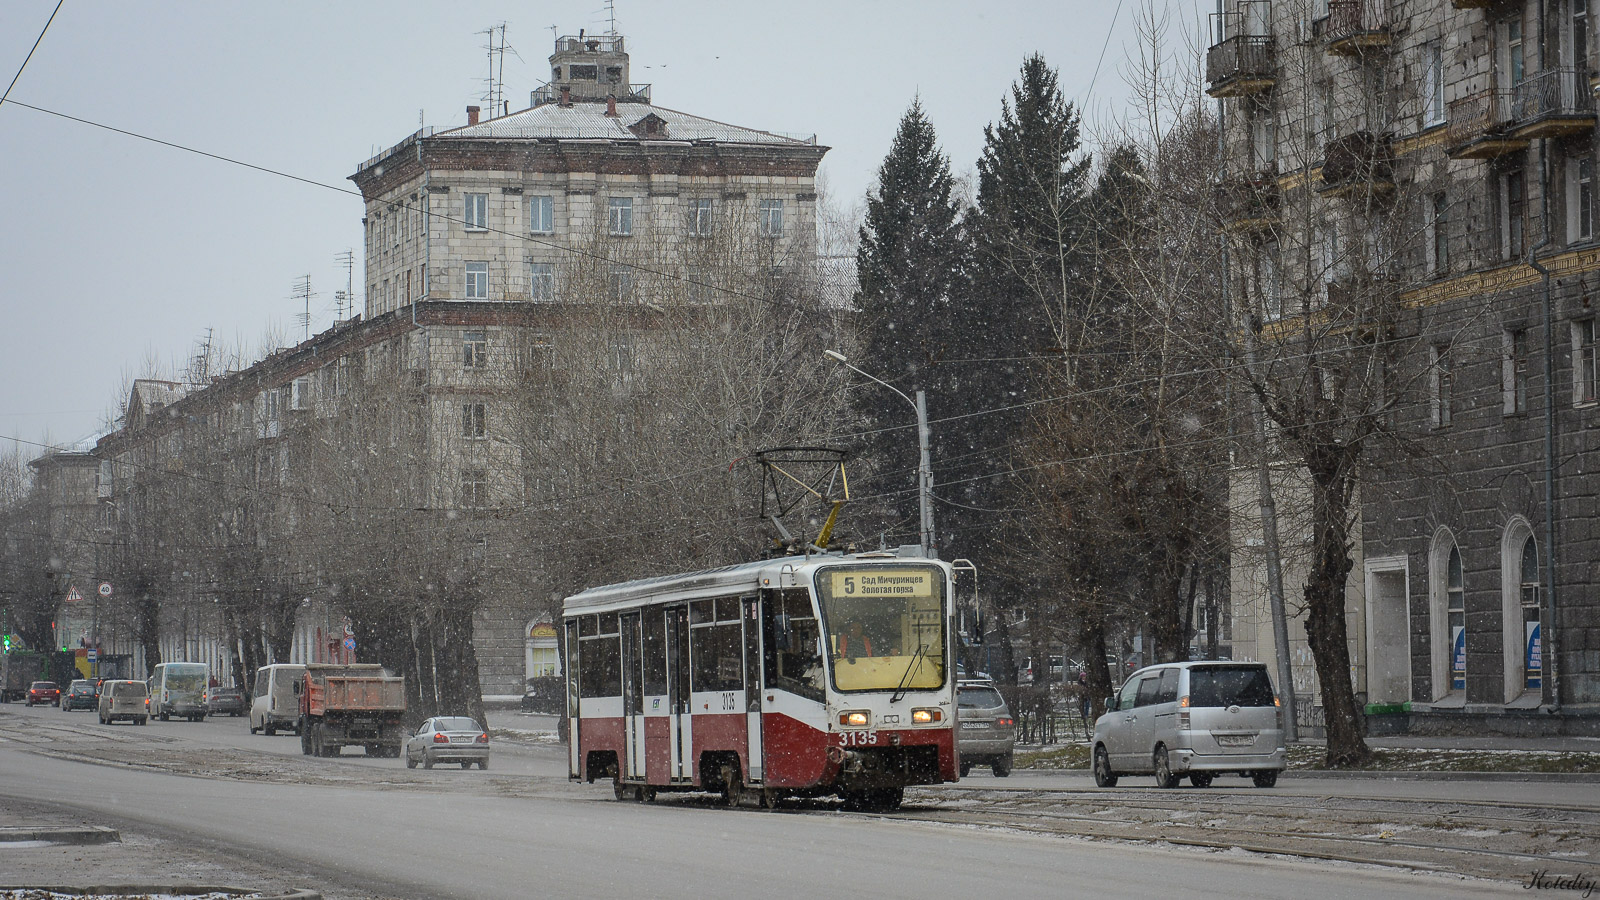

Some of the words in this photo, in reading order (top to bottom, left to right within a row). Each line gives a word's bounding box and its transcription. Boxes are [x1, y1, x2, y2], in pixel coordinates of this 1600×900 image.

[844, 577, 854, 594] 5
[861, 576, 876, 584] Сад
[877, 576, 923, 584] Мичуринцев
[861, 586, 892, 594] Золотая
[893, 586, 914, 594] горка
[722, 692, 735, 710] 3135
[838, 730, 877, 746] 3135
